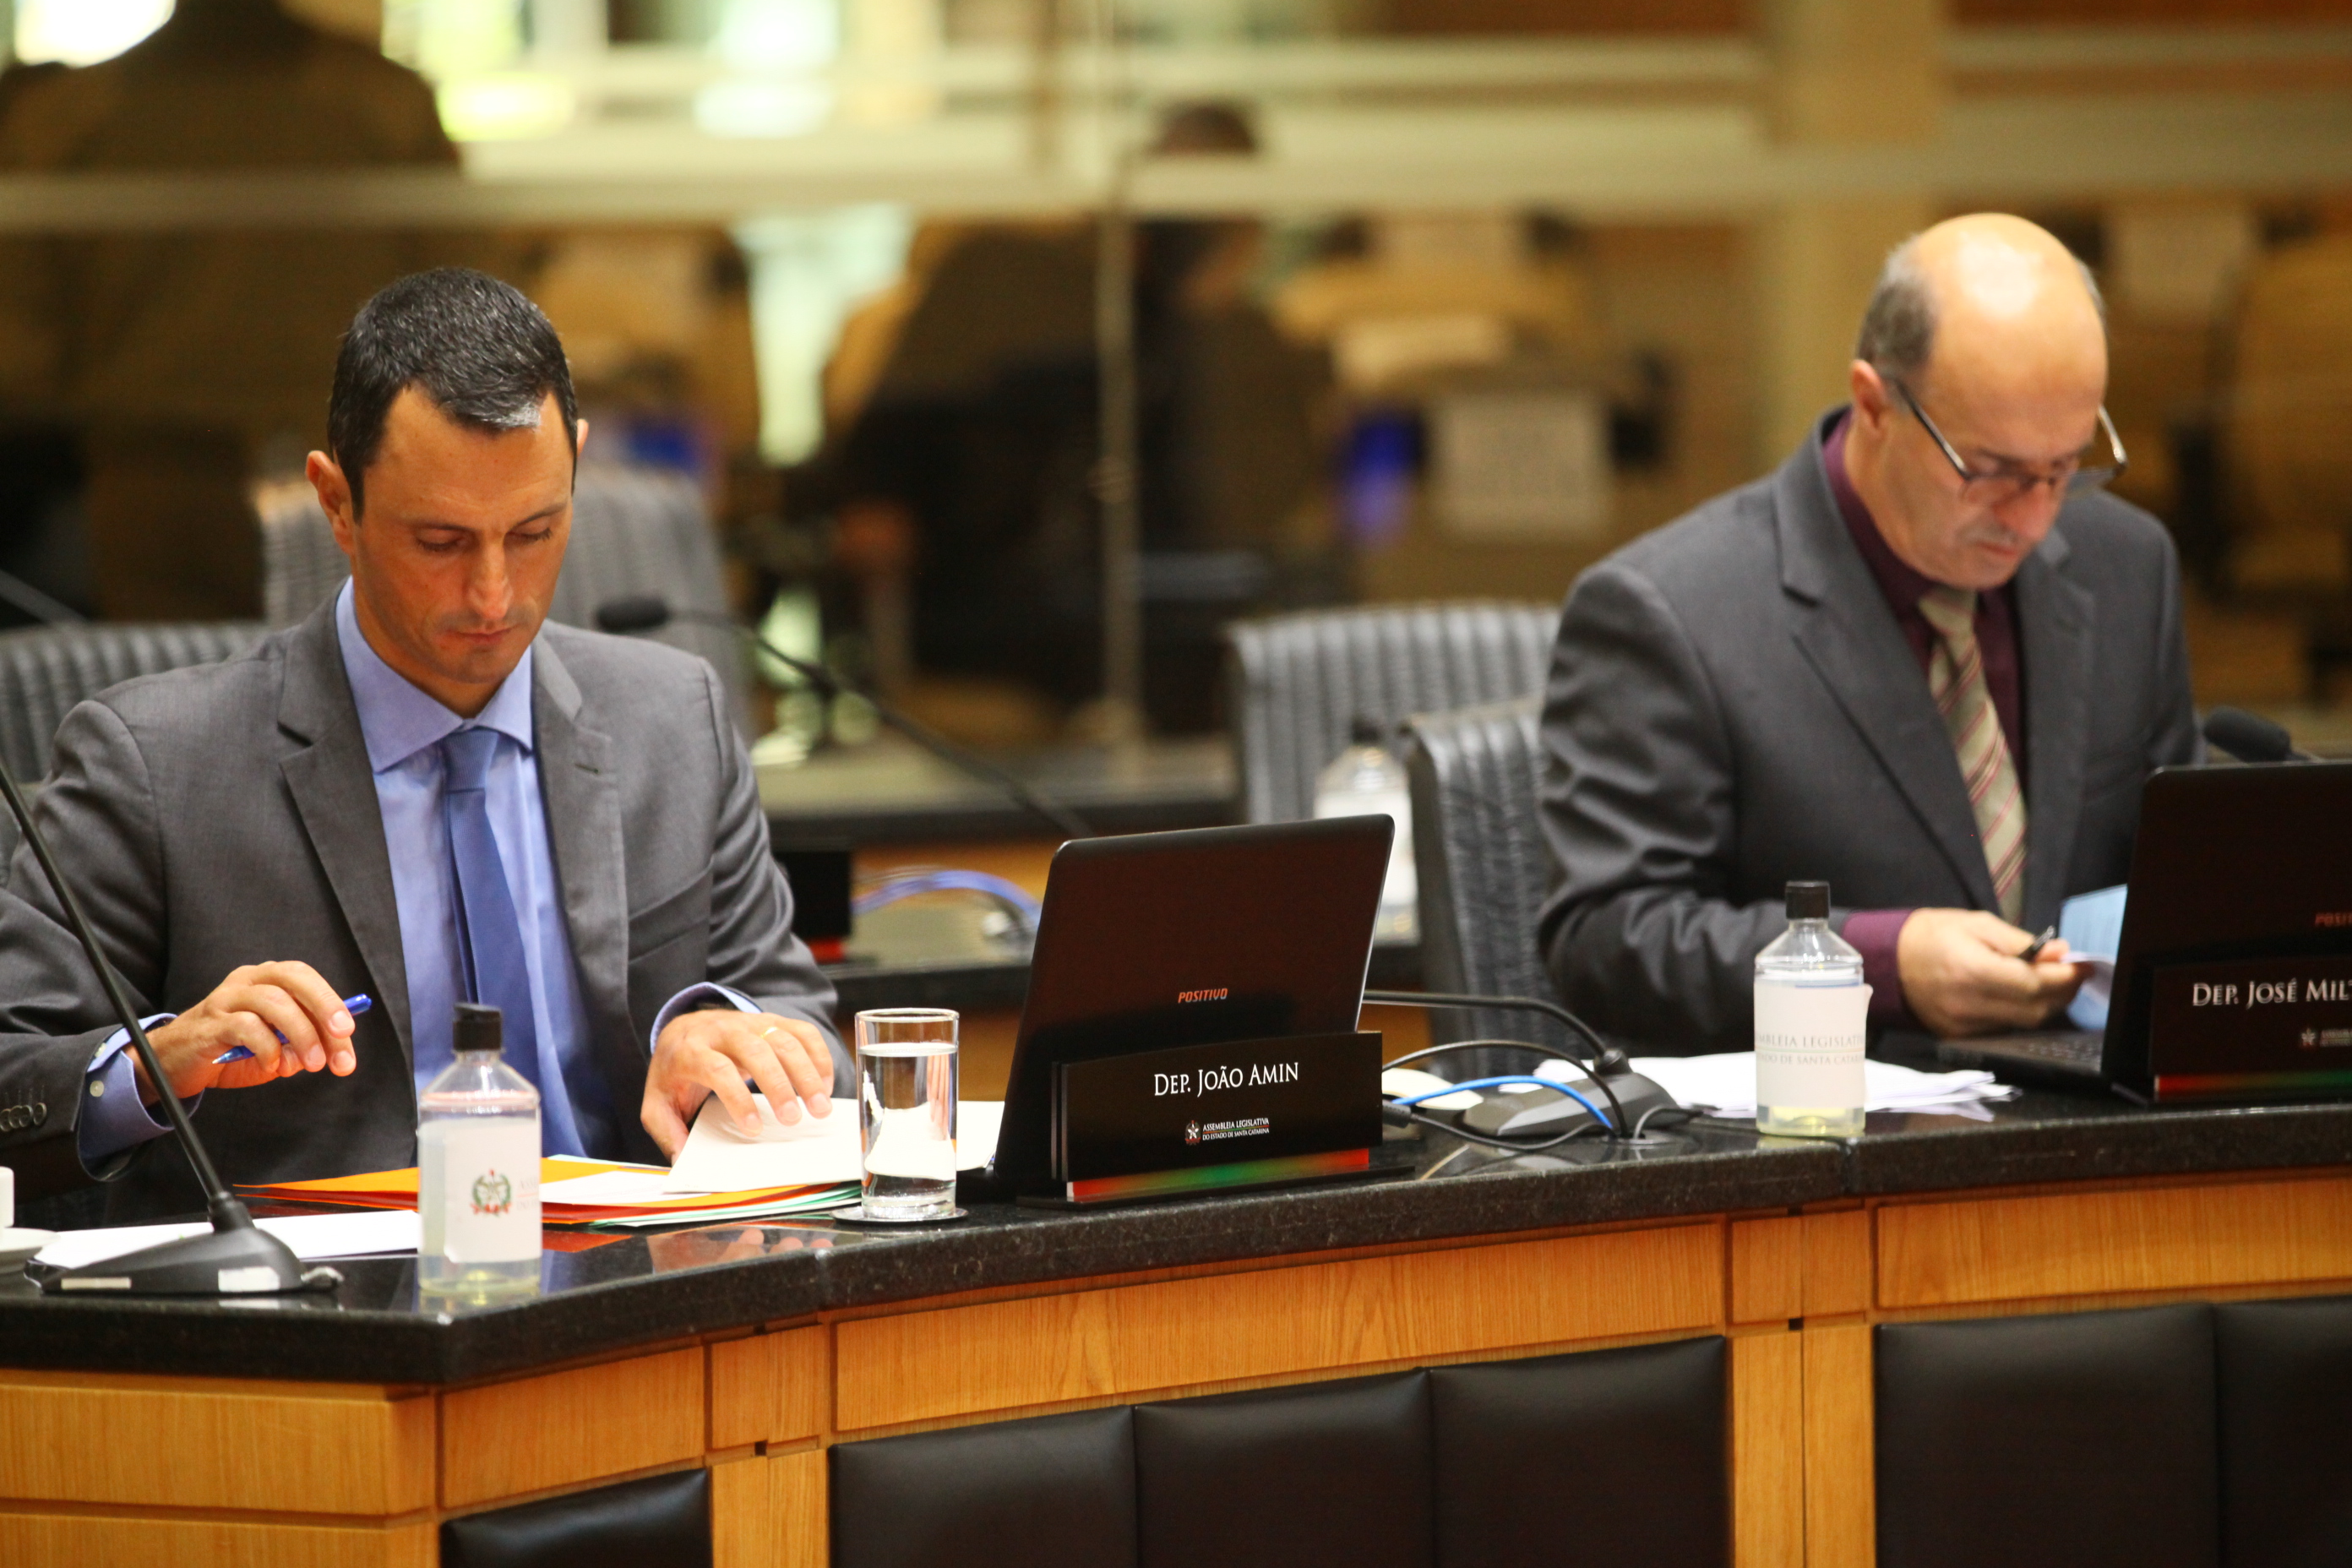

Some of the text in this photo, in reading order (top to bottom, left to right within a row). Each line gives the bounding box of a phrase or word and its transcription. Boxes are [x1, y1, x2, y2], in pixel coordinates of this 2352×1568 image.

[1178, 988, 1228, 1004] POSITIVO
[2246, 977, 2297, 1010] JOSÉ
[1197, 1065, 1244, 1097] JOÃO
[1249, 1062, 1298, 1086] AMIN
[1203, 1118, 1269, 1132] ASSEMBLEIA LEGISLATIVA
[1210, 1131, 1227, 1140] ESTADO
[1234, 1129, 1248, 1137] SANTA
[1248, 1128, 1270, 1136] CATARINA
